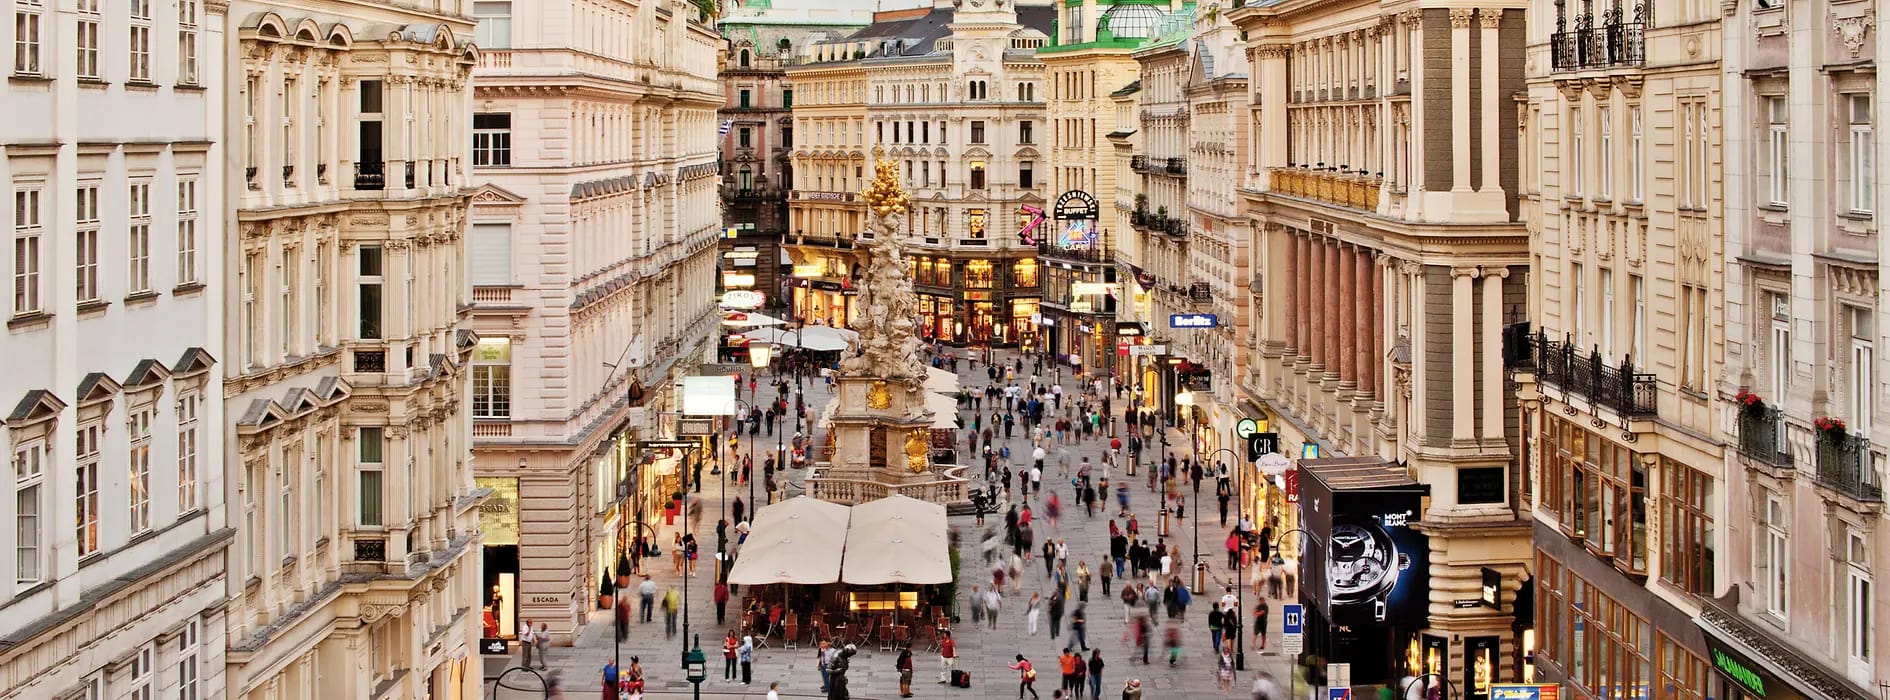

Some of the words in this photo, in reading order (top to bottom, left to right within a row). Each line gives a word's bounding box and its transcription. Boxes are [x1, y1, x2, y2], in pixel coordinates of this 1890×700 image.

[1174, 316, 1212, 326] Berlitz
[1253, 438, 1271, 453] GR
[1384, 519, 1407, 527] BLANC
[1713, 648, 1766, 697] SALAMANDER
